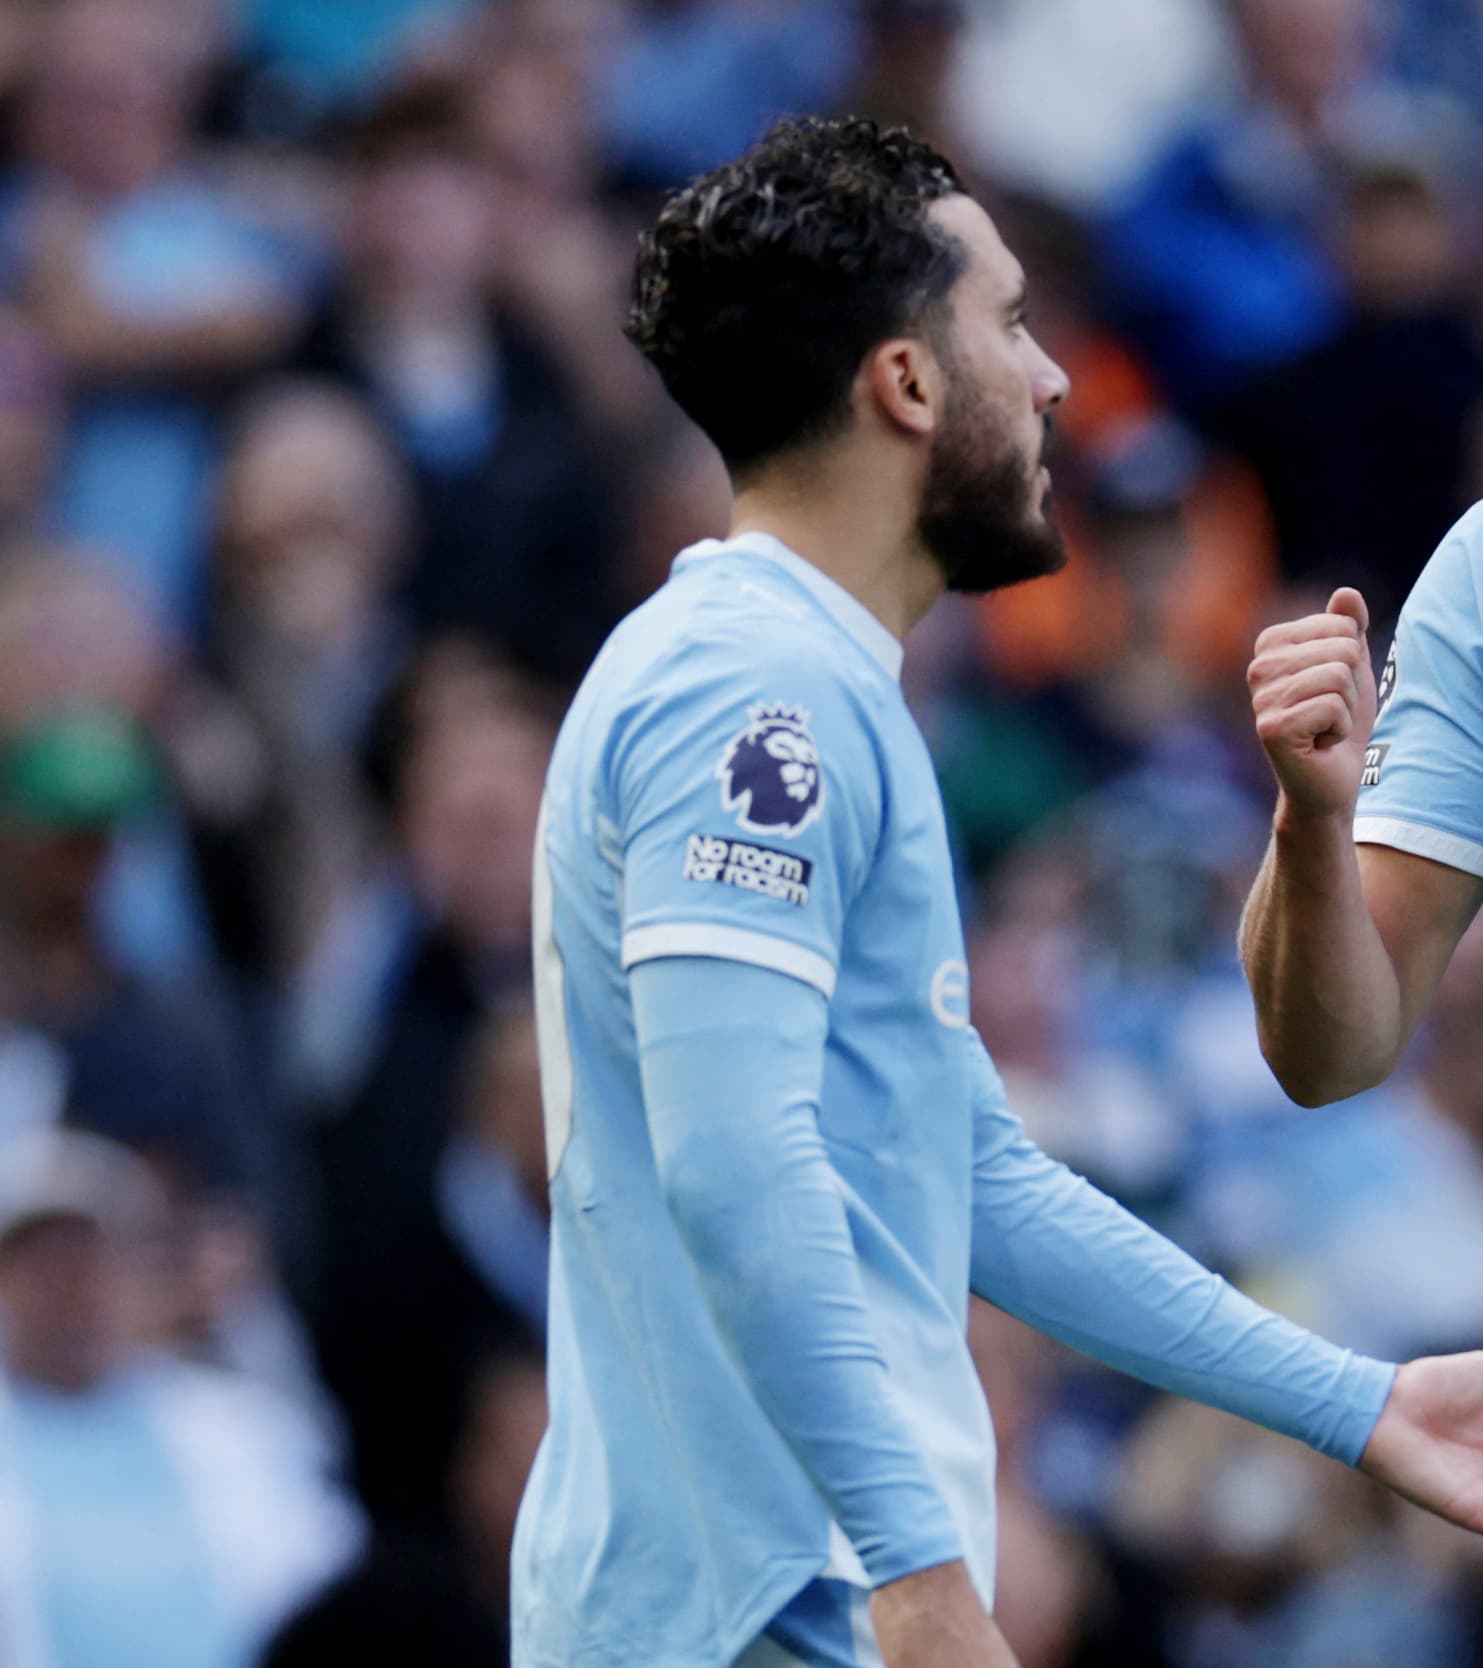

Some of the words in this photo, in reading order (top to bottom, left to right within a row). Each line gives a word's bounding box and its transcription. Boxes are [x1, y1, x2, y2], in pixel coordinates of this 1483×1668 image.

[683, 860, 725, 881] for
[687, 834, 728, 862] No
[730, 842, 803, 881] room
